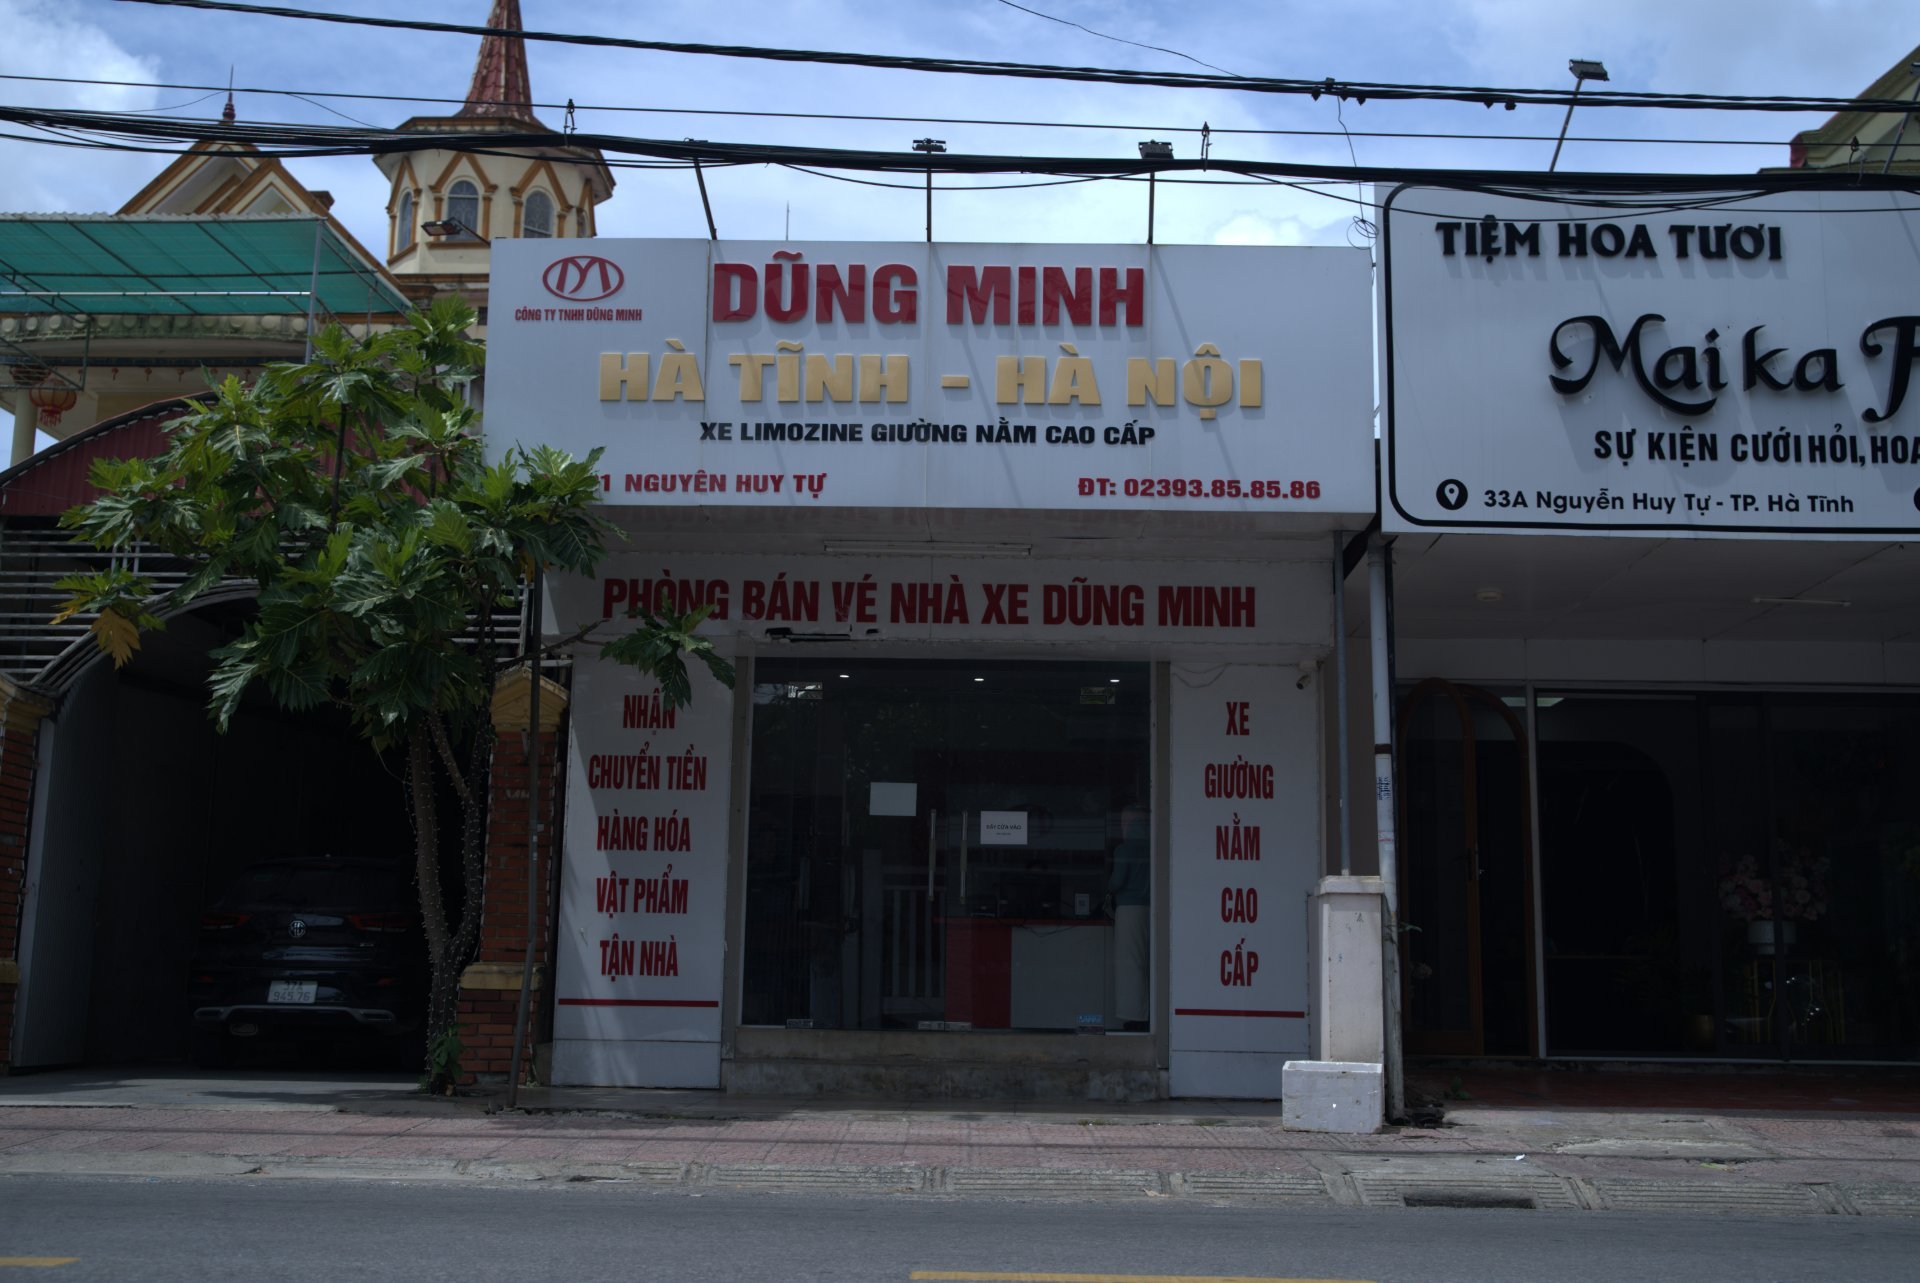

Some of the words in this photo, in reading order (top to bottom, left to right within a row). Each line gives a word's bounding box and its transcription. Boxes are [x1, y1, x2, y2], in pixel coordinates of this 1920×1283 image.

[1435, 215, 1541, 263] TIỆM
[1558, 223, 1657, 260] HOA
[1669, 222, 1783, 261] TƯƠI
[713, 250, 917, 325] DŨNG
[946, 265, 1144, 327] MINH
[515, 306, 542, 321] CÔNG
[544, 309, 557, 321] TY
[558, 309, 584, 321] TNHH
[586, 306, 613, 321] DŨNG
[615, 309, 642, 321] MINH
[599, 338, 704, 402] HÀ
[729, 340, 909, 403] TĨNH
[941, 374, 970, 389] -
[996, 342, 1101, 406] HÀ
[1127, 342, 1262, 421] NỘI
[700, 421, 732, 441] XE
[740, 422, 863, 442] LIMOZINE
[871, 418, 967, 443] GIƯỜNG
[976, 416, 1037, 444] NẰM
[1045, 425, 1096, 445] CAO
[1104, 419, 1156, 445] CẤP
[1594, 429, 1638, 466] SỰ
[1648, 425, 1718, 467] KIỆN
[1730, 426, 1802, 464] CƯỚI
[1808, 424, 1866, 467] HỎI,
[625, 469, 727, 492] NGUYÊN
[736, 474, 785, 493] HUY
[793, 472, 827, 499] TỰ
[1078, 477, 1116, 497] ĐT:
[1124, 478, 1321, 499] 02393.85.85.86
[1483, 490, 1529, 509] 33A
[1536, 487, 1624, 515] Nguyễn
[1632, 493, 1676, 515] Huy
[1684, 493, 1712, 518] Tự
[1730, 494, 1760, 513] TP.
[1768, 490, 1800, 513] Hà
[1807, 493, 1855, 514] Tĩnh
[603, 568, 729, 621] PHÒNG
[742, 571, 819, 622] BÁN
[832, 573, 878, 623] VÉ
[890, 574, 969, 624] NHÀ
[981, 583, 1029, 625] XE
[1043, 576, 1144, 626] DŨNG
[1158, 586, 1256, 628] MINH
[1226, 702, 1250, 736] XE
[588, 741, 661, 791] CHUYỂN
[667, 744, 707, 791] TIỀN
[1204, 755, 1274, 799] GIƯỜNG
[597, 809, 648, 852] HÀNG
[653, 809, 691, 852] HÓA
[1216, 812, 1260, 861] NẰM
[596, 871, 629, 918] VẬT
[634, 863, 689, 914] PHẨM
[1221, 887, 1258, 923] CAO
[600, 932, 634, 982] TẬN
[640, 935, 678, 977] NHÀ
[1220, 938, 1259, 987] CẤP
